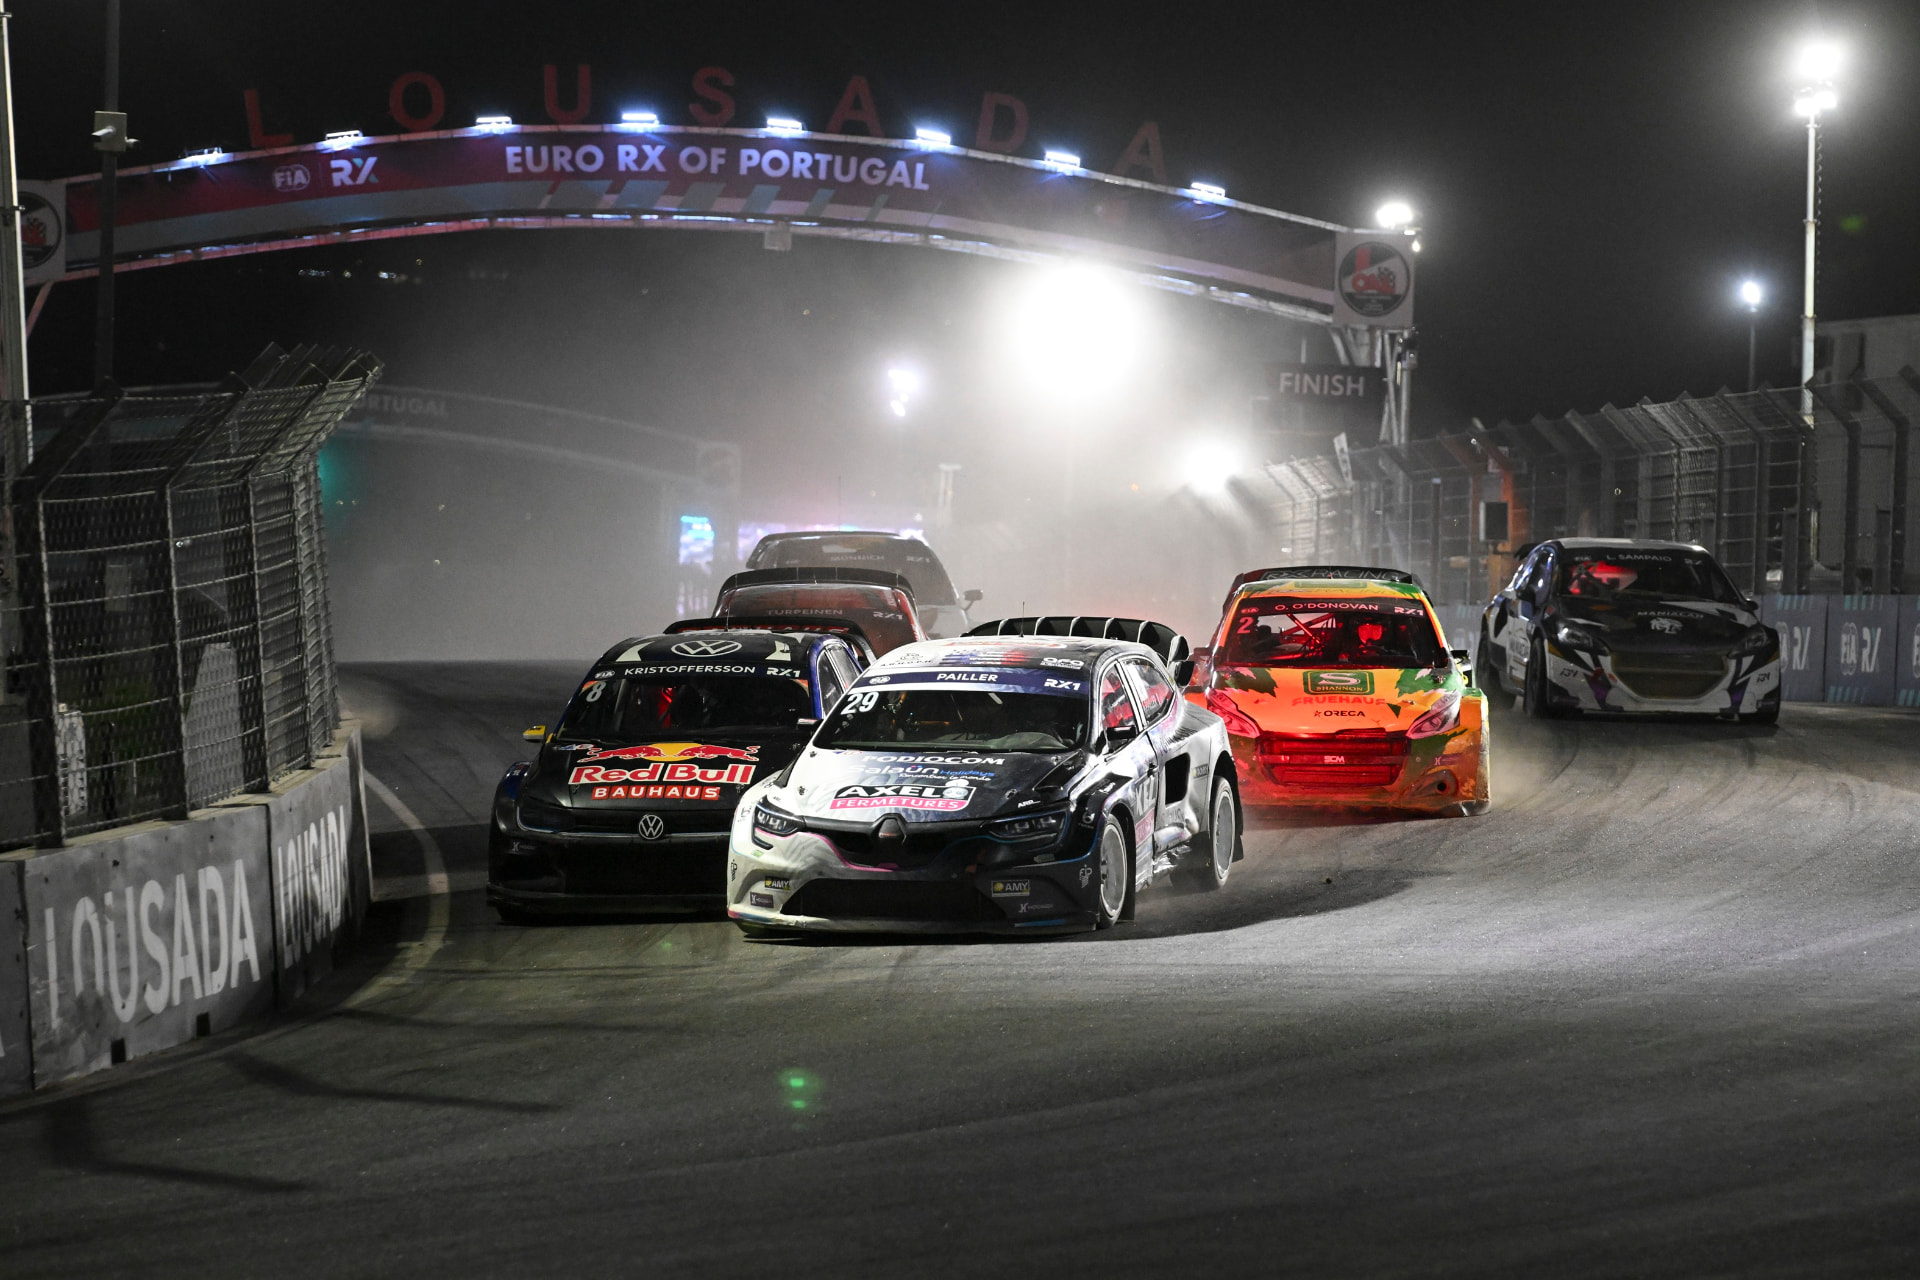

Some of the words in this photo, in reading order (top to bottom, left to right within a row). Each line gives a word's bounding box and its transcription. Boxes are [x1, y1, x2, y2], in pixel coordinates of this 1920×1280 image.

[330, 157, 379, 187] RX
[506, 145, 604, 174] EURO
[617, 145, 667, 172] RX
[679, 147, 726, 175] OF
[739, 149, 931, 190] PORTUGAL
[1279, 372, 1365, 397] FINISH
[1618, 554, 1672, 562] SAMPAIO
[766, 608, 844, 616] TURPEINEN
[1292, 602, 1380, 612] O'DONOVAN
[1393, 606, 1425, 617] RX1
[1236, 616, 1252, 635] 2
[624, 665, 756, 676] KRISTOFFERSSON
[766, 667, 801, 678] RX1
[936, 673, 999, 682] PAILLER
[1044, 678, 1081, 691] RX1
[585, 680, 607, 702] 8
[841, 691, 879, 715] 29
[863, 755, 1005, 766] PODIOCOM
[568, 763, 664, 784] Red
[663, 764, 756, 784] Bull
[594, 785, 719, 799] BAUHAUS
[837, 786, 942, 798] AXEL
[836, 799, 959, 809] FERMETURES
[771, 880, 789, 888] AMY
[1005, 882, 1028, 891] AMY
